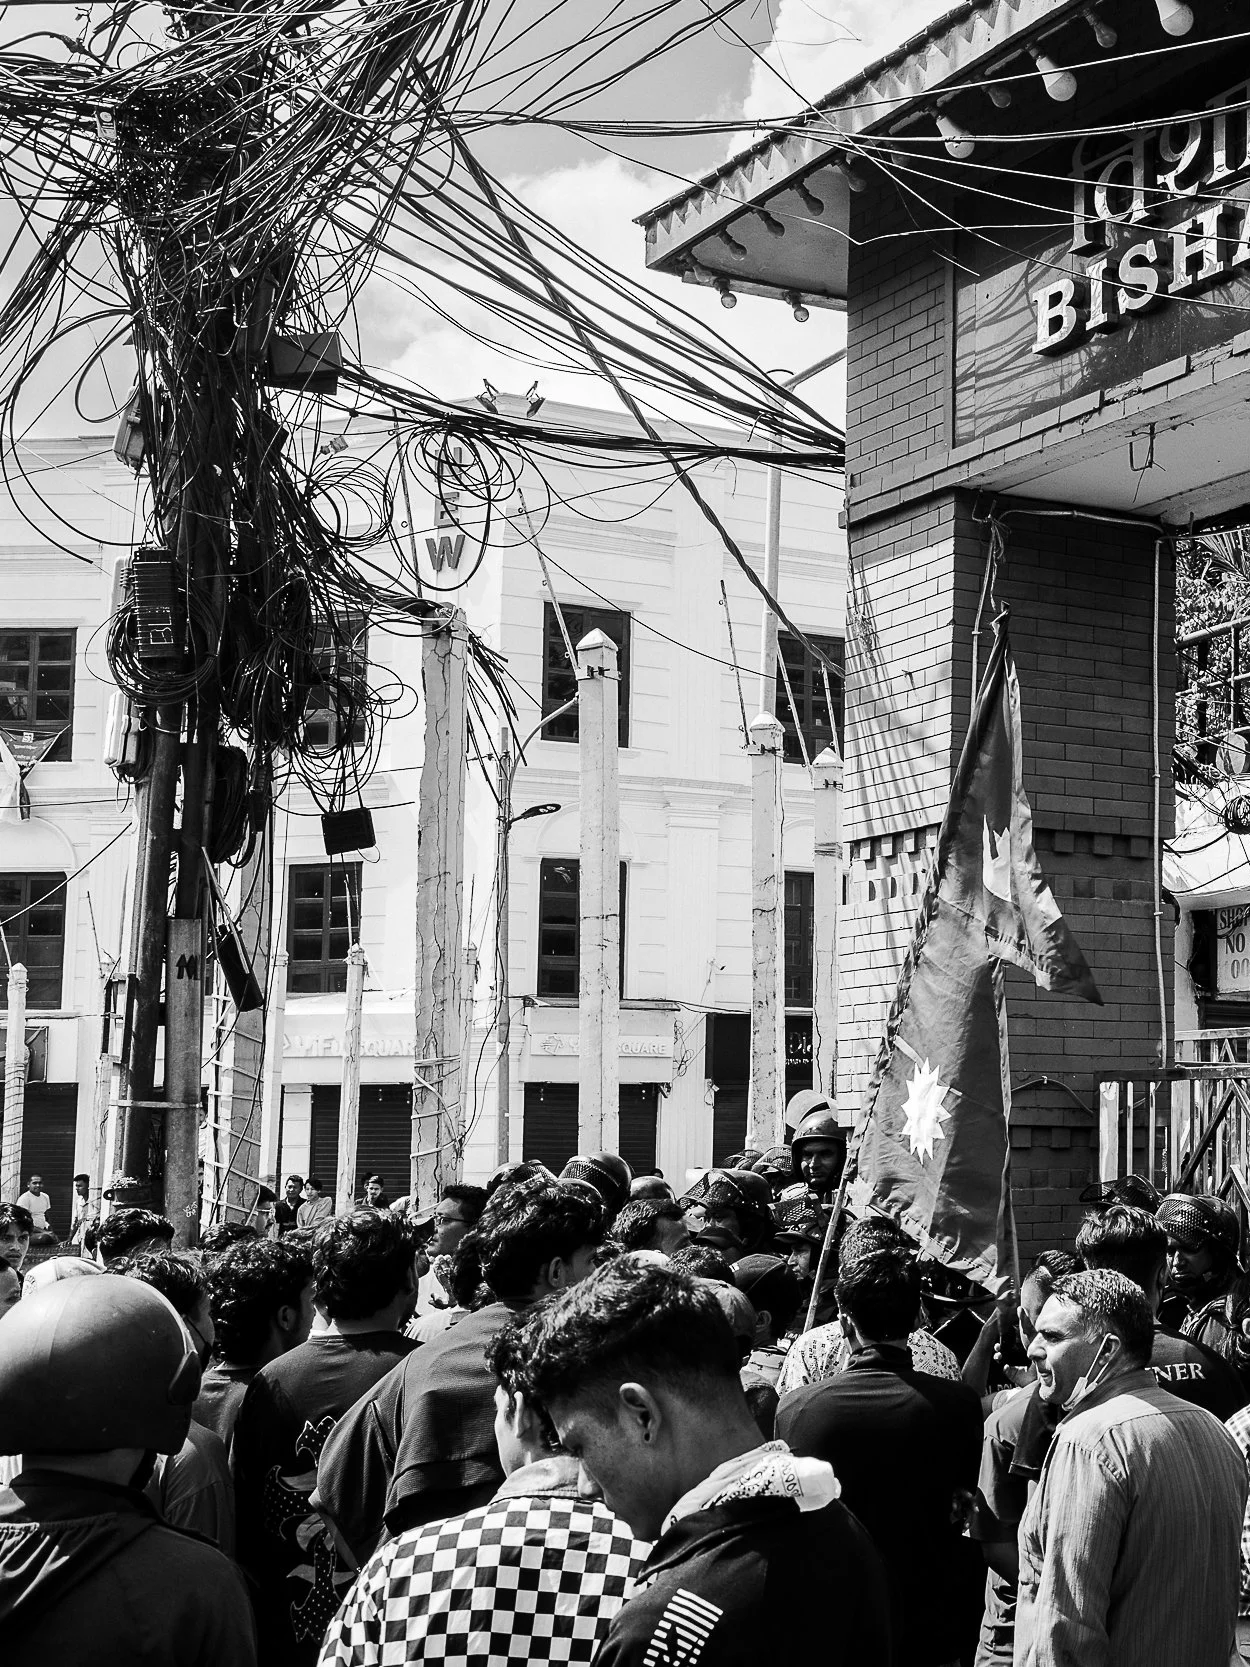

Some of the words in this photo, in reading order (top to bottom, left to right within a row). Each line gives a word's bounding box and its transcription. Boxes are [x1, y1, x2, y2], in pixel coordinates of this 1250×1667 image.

[1225, 932, 1246, 955] NO
[619, 1041, 667, 1056] QUARE
[1145, 1362, 1207, 1384] NER
